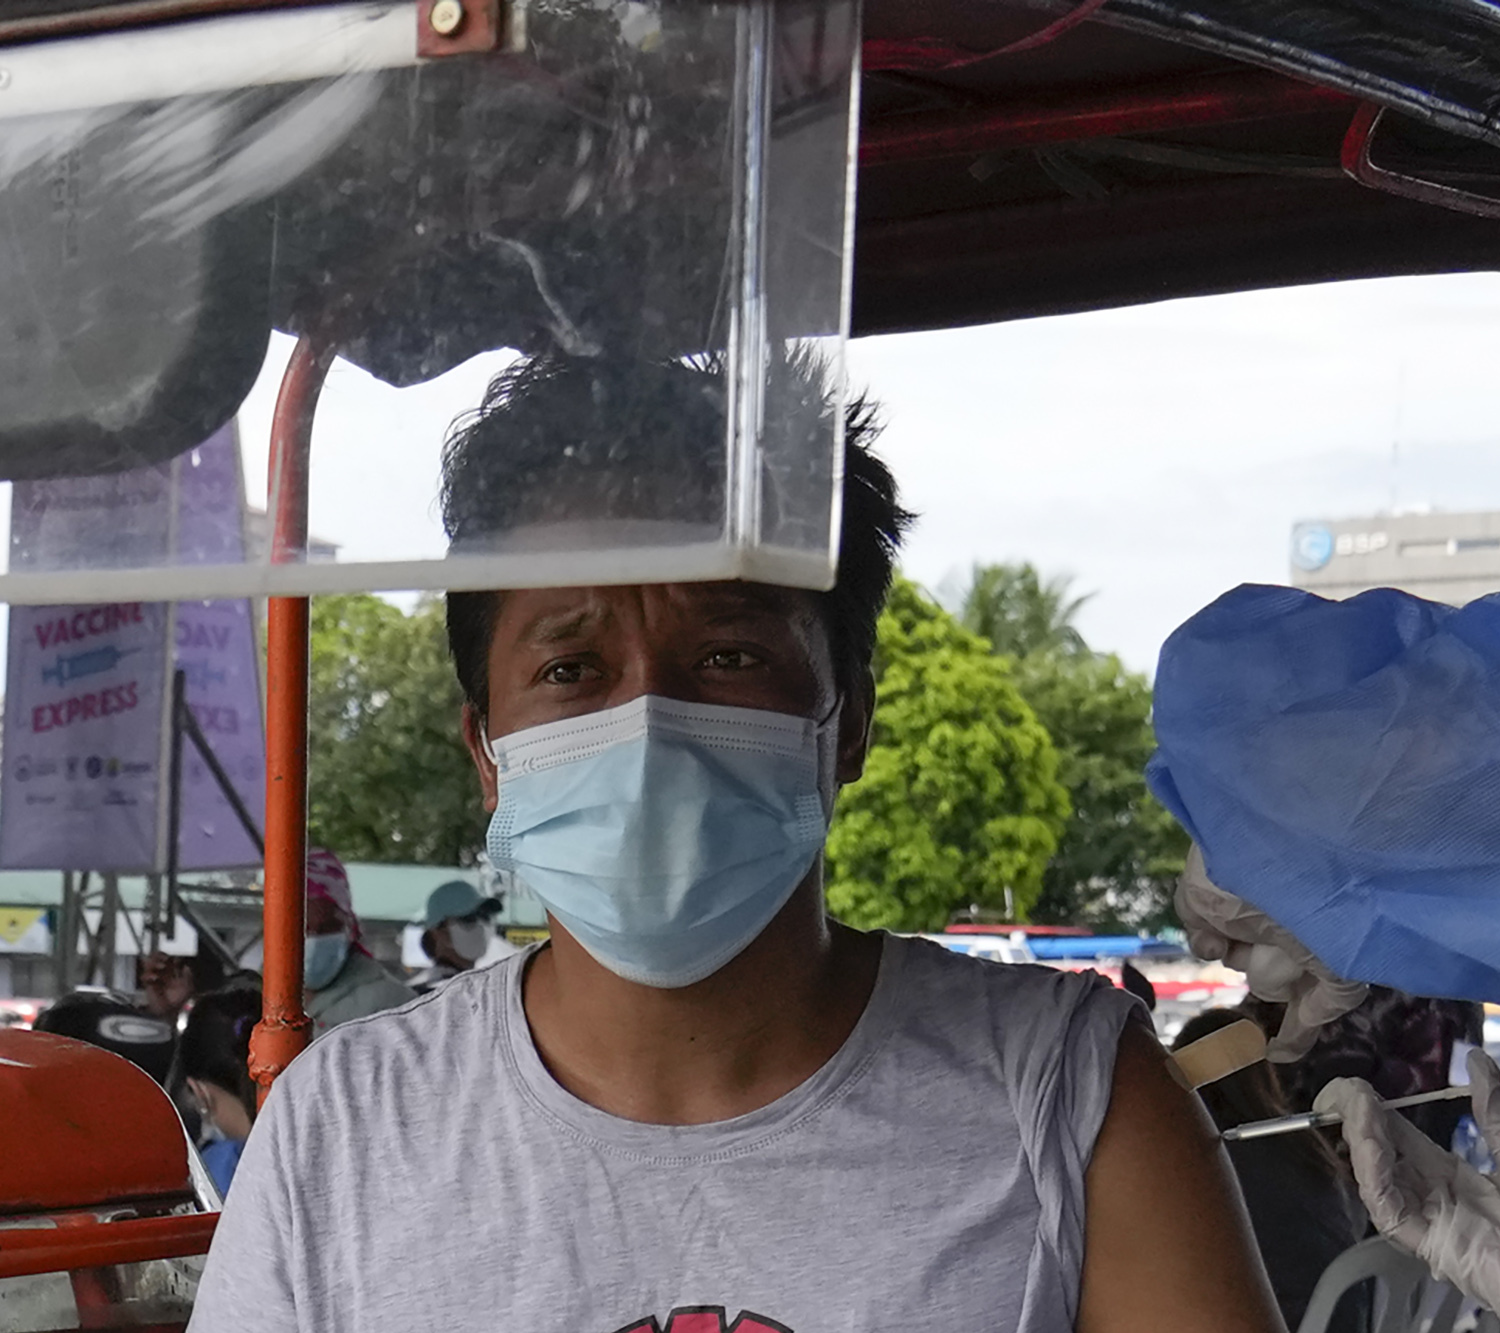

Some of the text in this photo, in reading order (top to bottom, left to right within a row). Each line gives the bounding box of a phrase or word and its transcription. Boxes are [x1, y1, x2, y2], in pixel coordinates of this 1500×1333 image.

[1336, 532, 1388, 555] BSP
[35, 600, 145, 650] VACCINE
[31, 681, 138, 734] EXPRESS
